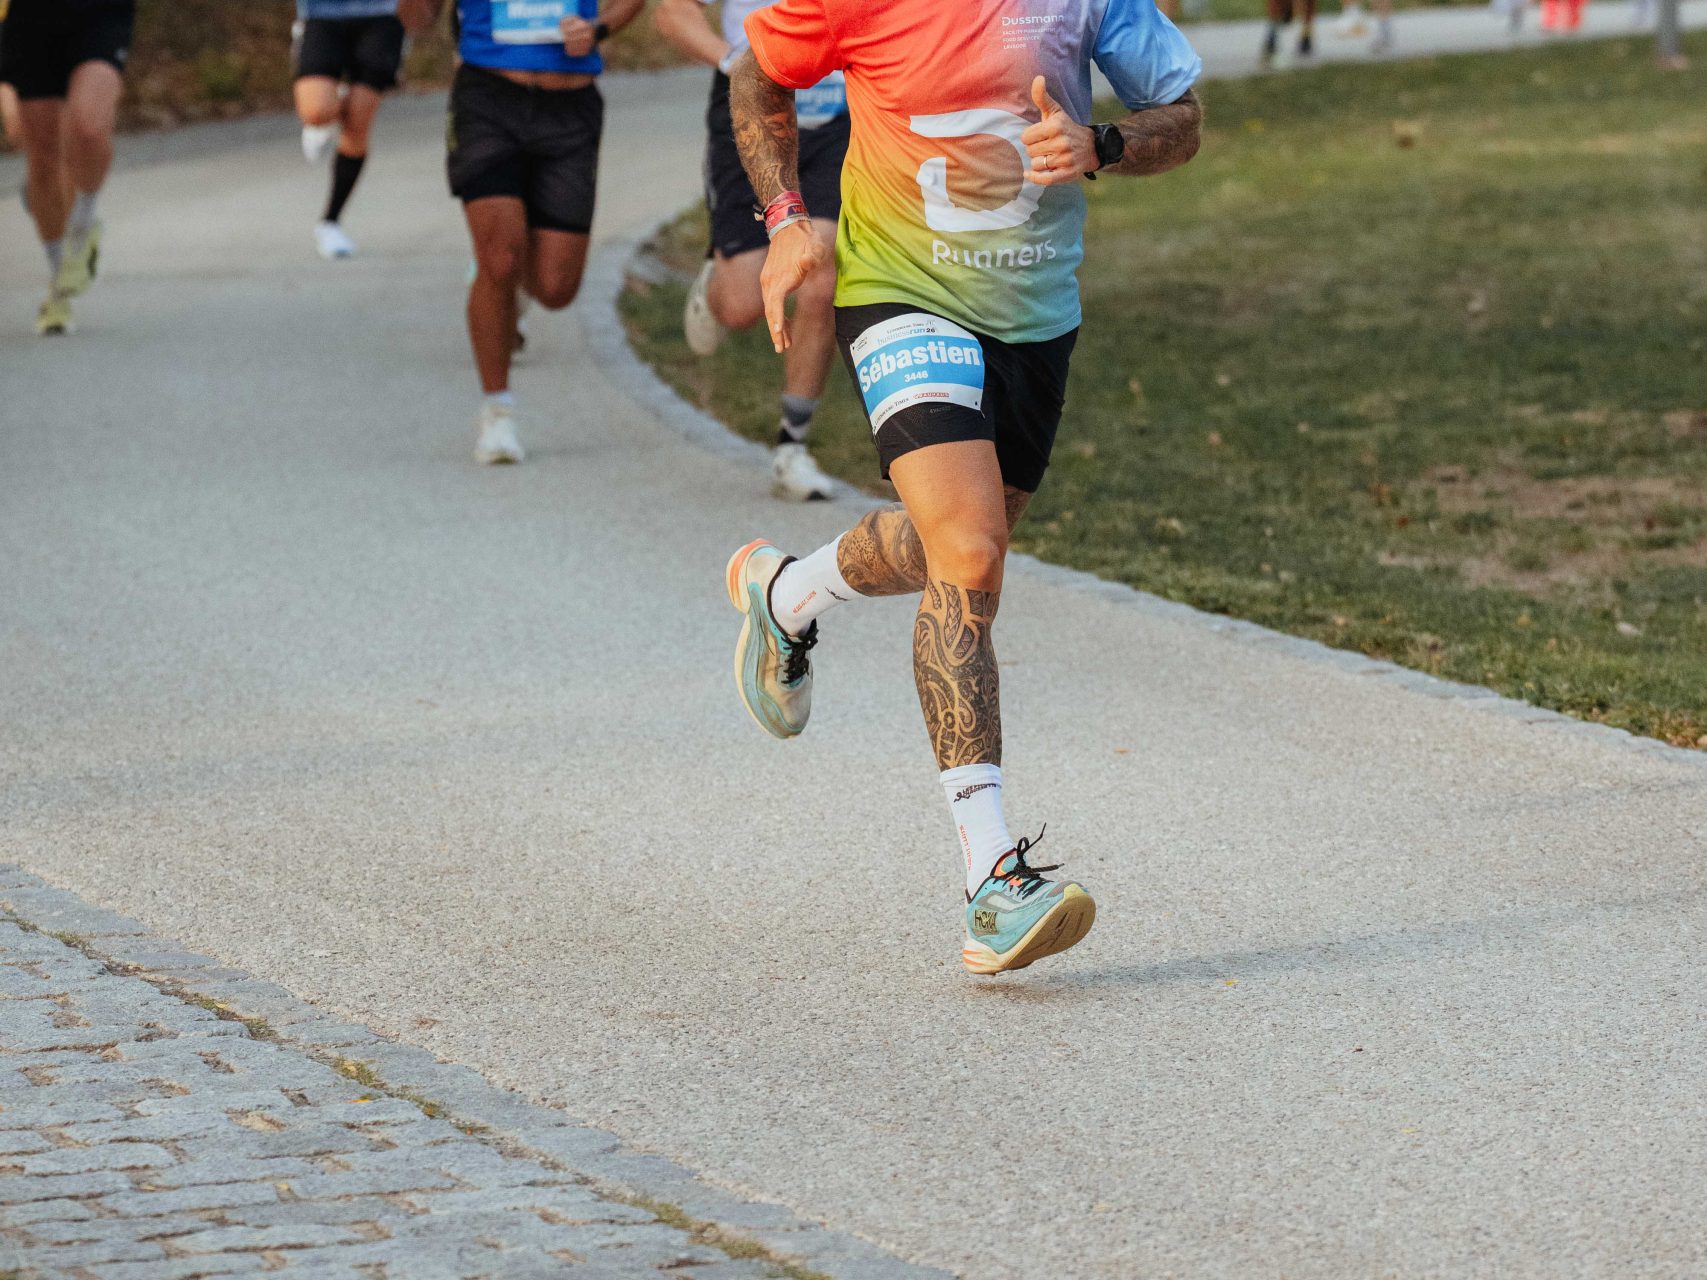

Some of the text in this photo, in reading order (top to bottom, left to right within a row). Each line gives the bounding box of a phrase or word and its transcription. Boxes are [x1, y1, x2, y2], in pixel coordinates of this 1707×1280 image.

[1001, 14, 1064, 26] Dussmann
[932, 239, 1057, 268] Runners
[859, 341, 980, 393] Sébastien
[975, 910, 997, 933] HOKA
